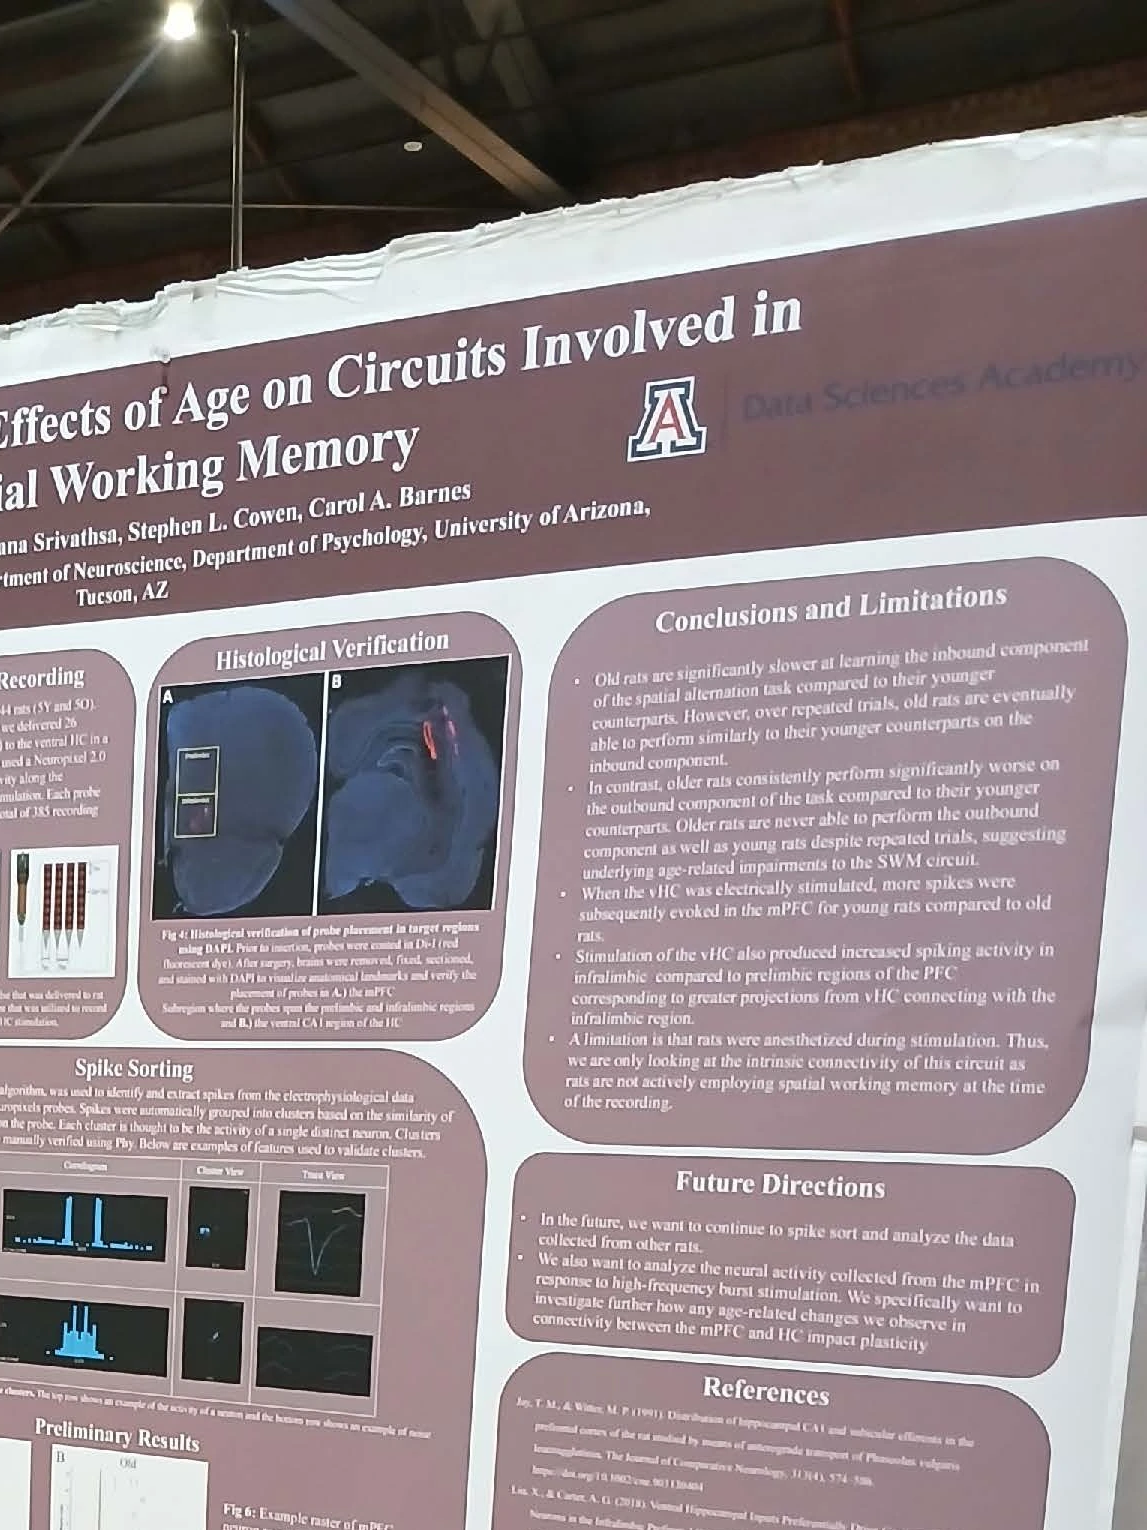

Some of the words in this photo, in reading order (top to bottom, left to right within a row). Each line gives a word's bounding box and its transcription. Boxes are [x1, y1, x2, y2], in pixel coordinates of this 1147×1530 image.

[124, 386, 167, 430] of
[172, 381, 249, 430] Age
[262, 374, 312, 409] on
[328, 337, 506, 397] Circuits
[520, 295, 734, 370] Involved
[752, 289, 801, 336] in
[742, 391, 812, 422] Data
[822, 373, 966, 412] Sciences
[980, 352, 1140, 392] Academy
[49, 450, 224, 504] Working
[236, 426, 420, 481] Memory
[33, 526, 122, 551] Srivathsa,
[127, 516, 202, 544] Stephen
[208, 512, 227, 532] L.
[233, 506, 302, 528] Cowen,
[308, 492, 364, 517] Carol
[369, 489, 391, 511] A.
[399, 484, 470, 507] Barnes
[52, 563, 71, 582] of
[74, 555, 186, 580] Neuroscience,
[192, 539, 294, 570] Department
[298, 534, 318, 554] of
[322, 525, 427, 554] Psychology,
[435, 510, 533, 538] University
[539, 506, 560, 526] of
[562, 500, 651, 522] Arizona,
[75, 588, 137, 606] Tucson,
[142, 580, 168, 600] AZ
[655, 603, 797, 633] Conclusions
[805, 595, 851, 619] and
[859, 585, 1007, 616] Limitations
[216, 640, 326, 670] Histological
[332, 630, 448, 658] Verification
[594, 671, 620, 687] Old
[623, 671, 648, 685] rats
[652, 671, 674, 682] are
[676, 660, 764, 683] significantly
[768, 657, 818, 673] slower
[820, 657, 834, 670] at
[839, 653, 900, 668] learning
[904, 648, 928, 664] the
[932, 642, 996, 661] inbound
[1000, 639, 1088, 658] component
[162, 690, 173, 703] A
[332, 675, 342, 688] B
[589, 755, 644, 773] inbound
[74, 1058, 122, 1081] Spike
[127, 1058, 193, 1083] Sorting
[676, 1170, 755, 1193] Future
[762, 1173, 885, 1198] Directions
[538, 1232, 596, 1248] collected
[600, 1234, 632, 1249] from
[636, 1237, 671, 1251] other
[703, 1376, 829, 1405] References
[35, 1417, 132, 1448] Preliminary
[138, 1428, 199, 1452] Results
[57, 1451, 65, 1462] B
